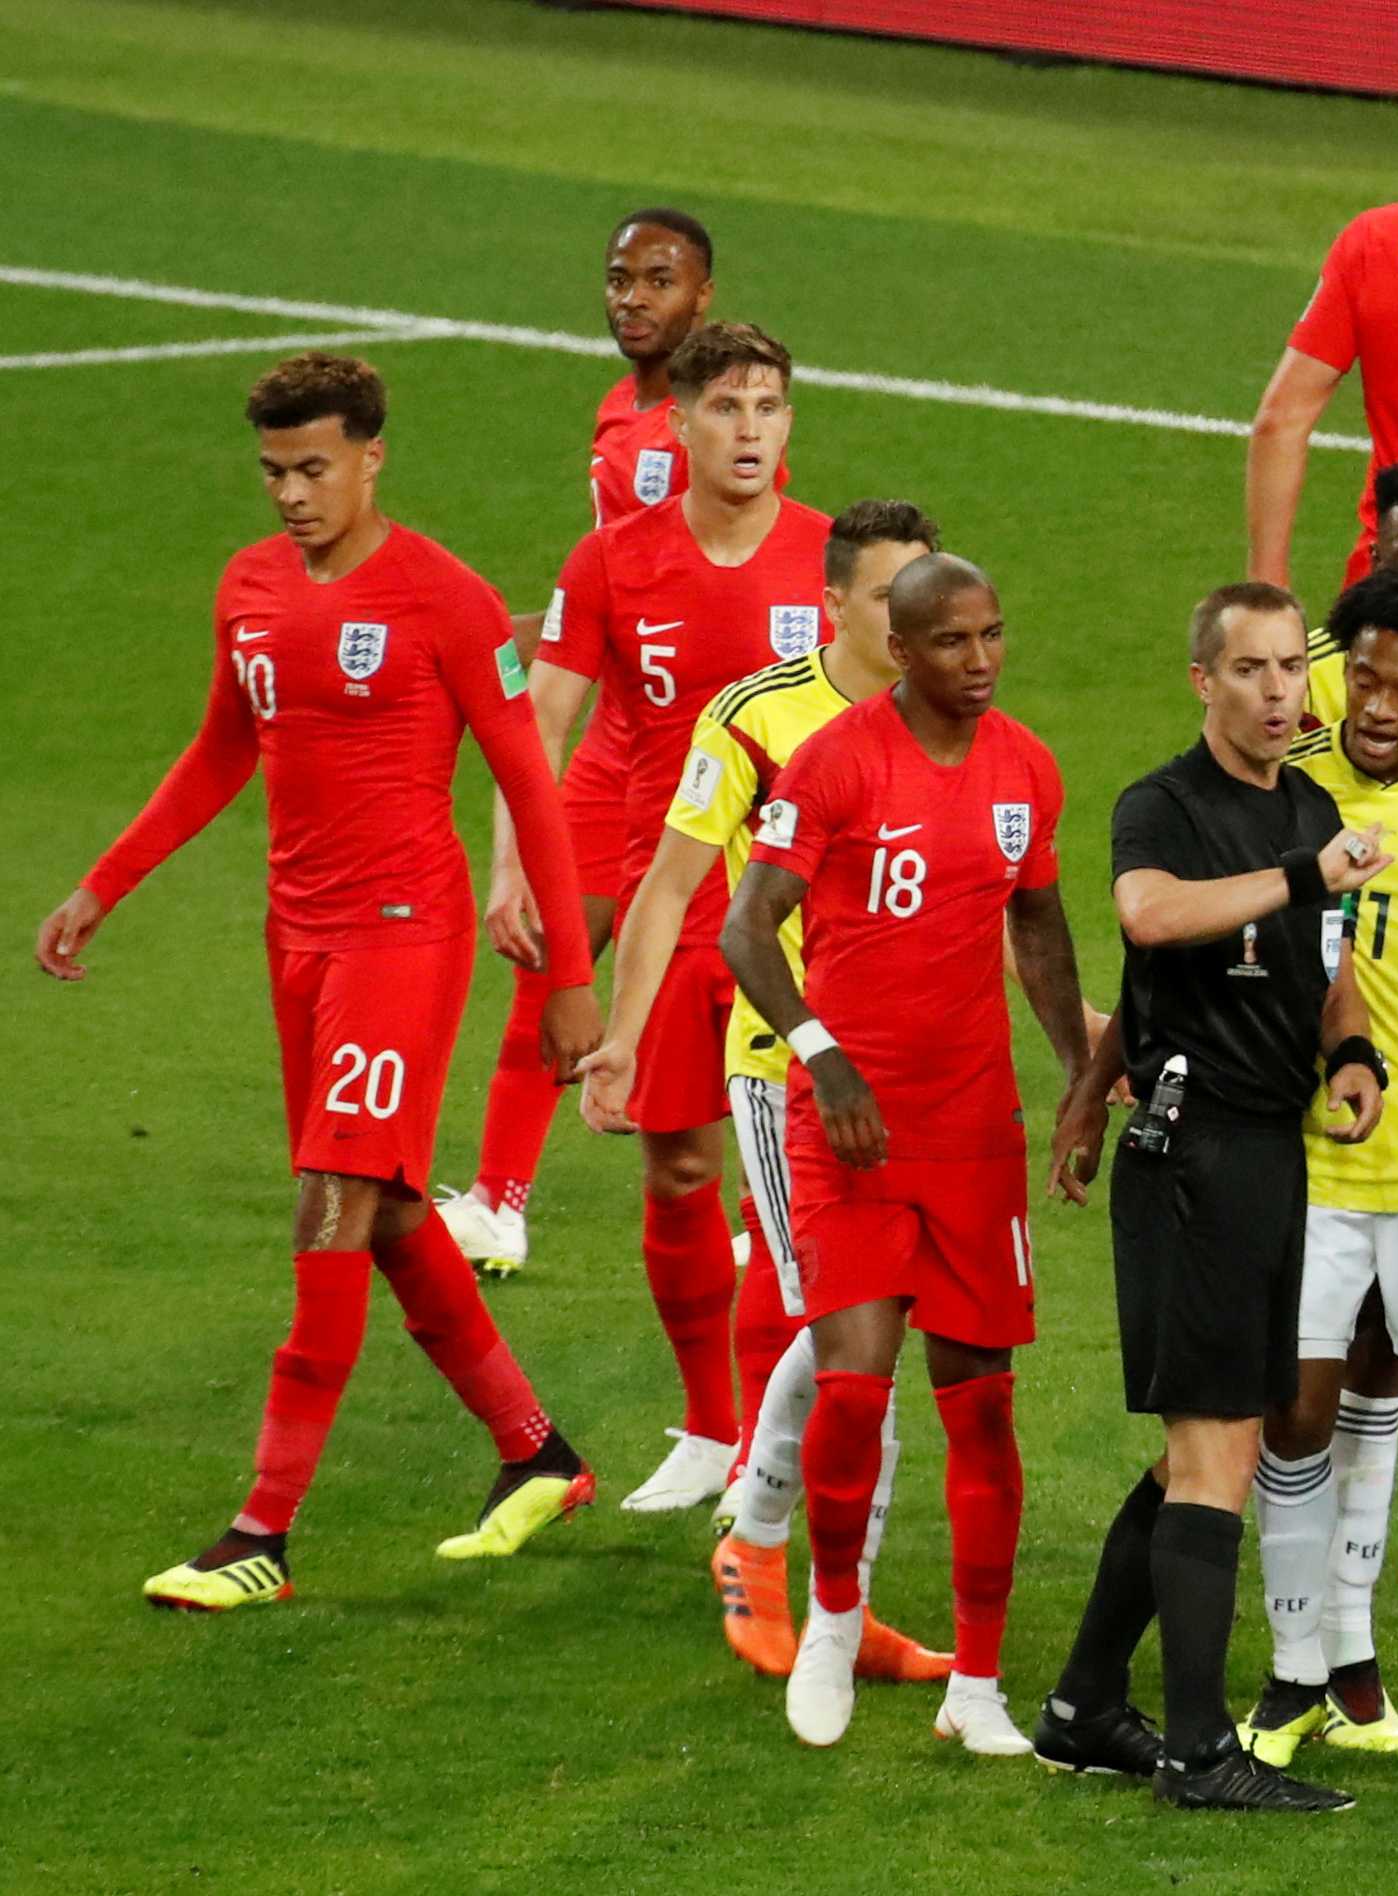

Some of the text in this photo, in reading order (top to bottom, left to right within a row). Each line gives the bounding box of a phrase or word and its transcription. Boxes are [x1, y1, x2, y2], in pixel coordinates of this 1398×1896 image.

[640, 643, 677, 708] 5
[867, 847, 927, 918] 18
[326, 1043, 405, 1119] 20
[1010, 1215, 1034, 1287] 1
[1273, 1597, 1310, 1613] FCF
